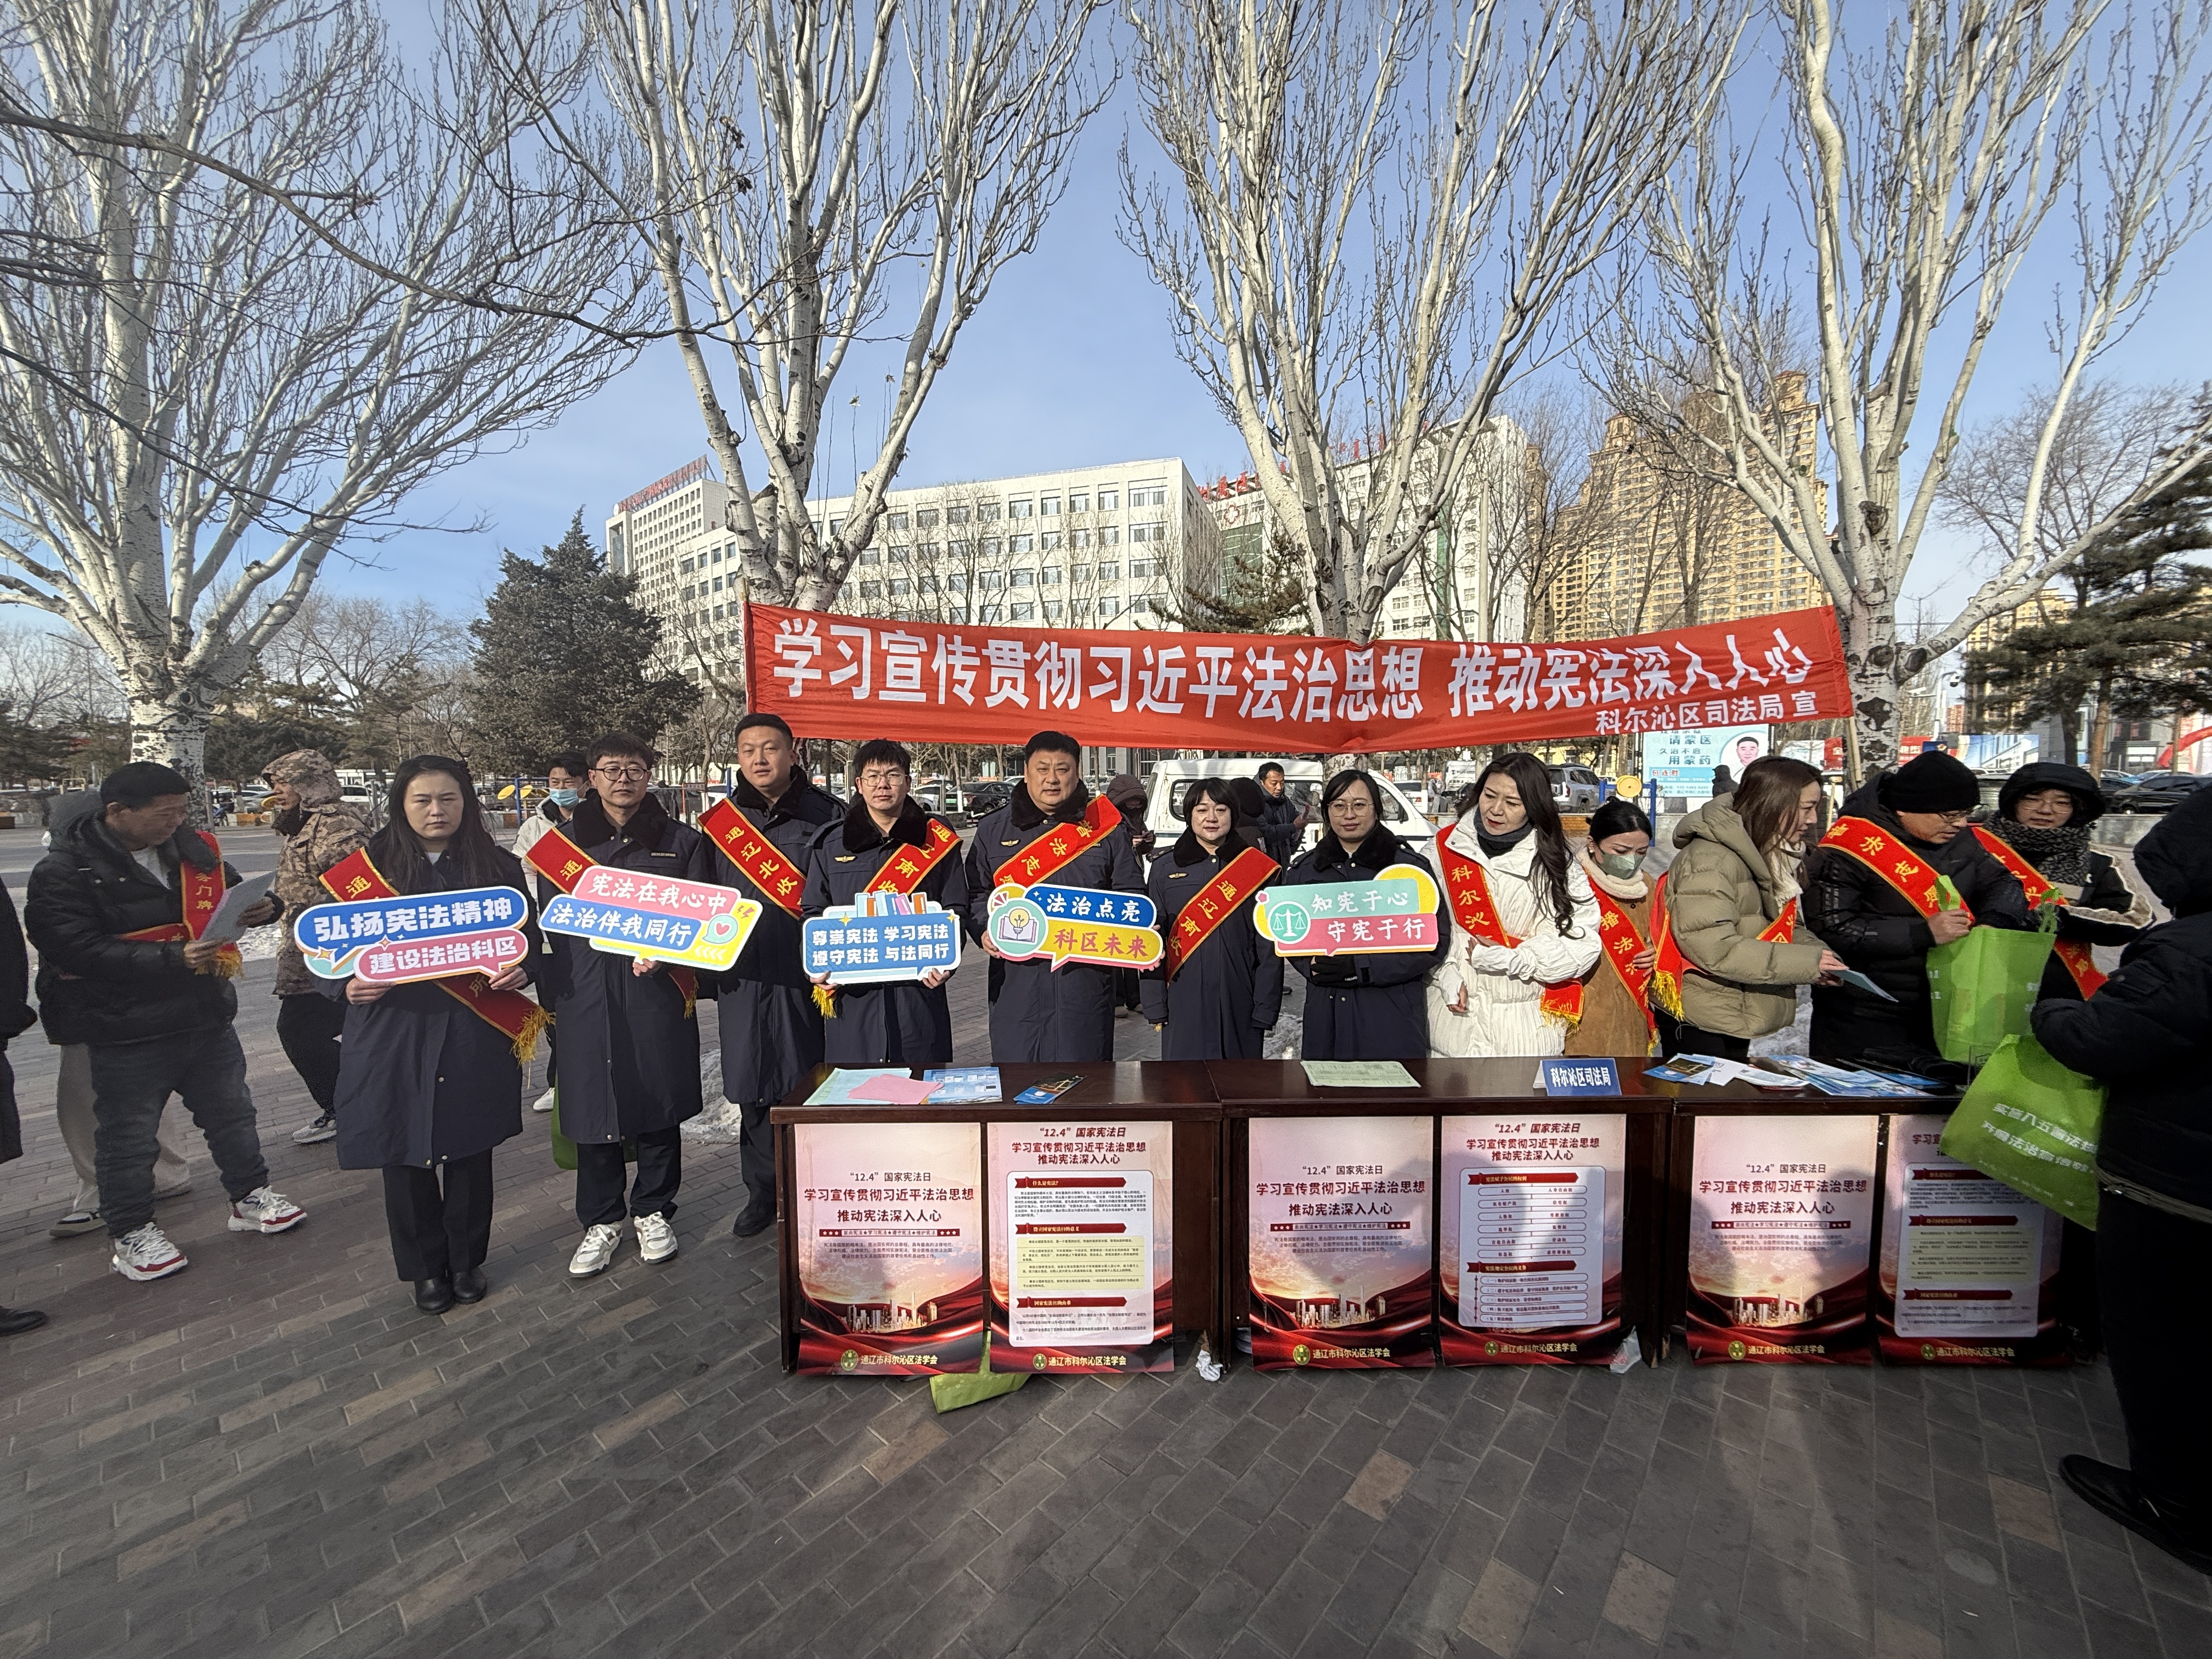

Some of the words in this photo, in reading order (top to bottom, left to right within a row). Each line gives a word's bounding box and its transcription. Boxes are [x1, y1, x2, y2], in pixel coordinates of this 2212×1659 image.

[774, 618, 1423, 723] 学习宣传贯彻习近平法治思想
[1448, 628, 1812, 717] 推动宪法深入人心
[1596, 693, 1784, 735] 科尔沁区司法局
[1792, 691, 1819, 718] 宣
[1669, 735, 1711, 744] 请蒙医
[1668, 755, 1711, 765] 用蒙药
[560, 859, 583, 881] 通
[346, 875, 373, 899] 通
[588, 873, 727, 915] 宪法在我心中
[1311, 890, 1408, 914] 知宪于心
[1452, 864, 1490, 929] 科尔沁
[1046, 893, 1141, 922] 法治点亮
[314, 898, 512, 942] 弘扬宪法精神
[550, 903, 692, 947] 法治伴我同行
[812, 927, 879, 946] 尊崇宪法
[884, 924, 949, 942] 学习宪法
[1327, 918, 1426, 943] 守宪于行
[1054, 928, 1149, 958] 科区未来
[369, 935, 518, 974] 建设法治科区
[812, 947, 879, 967] 遵守宪法
[884, 943, 950, 962] 与法同行
[1550, 1066, 1611, 1087] 科尔沁区司法局
[1012, 1142, 1147, 1153] 学习宣传贯彻习近平法治思想
[1466, 1138, 1600, 1150] 学习宣传贯彻习近平法治思想
[1037, 1154, 1120, 1165] 推动宪法深入人心
[1491, 1150, 1574, 1161] 推动宪法深入人心
[1256, 1180, 1426, 1195] 学习宣传贯彻习近平法治思想
[1699, 1180, 1867, 1193] 学习宣传贯彻习近平法治思想
[804, 1188, 974, 1201] 学习宣传贯彻习近平法治思想
[1289, 1203, 1393, 1216] 推动宪法深入人心
[1730, 1201, 1835, 1214] 推动宪法深入人心
[837, 1209, 942, 1222] 推动宪法深入人心
[1313, 1347, 1391, 1359] 通辽市科尔沁区法学会
[1500, 1343, 1578, 1353] 通辽市科尔沁区法学会
[1748, 1345, 1825, 1355] 通辽市科尔沁区法学会
[860, 1355, 939, 1367] 通辽市科尔沁区法学会
[1048, 1355, 1127, 1367] 通辽市科尔沁区法学会
